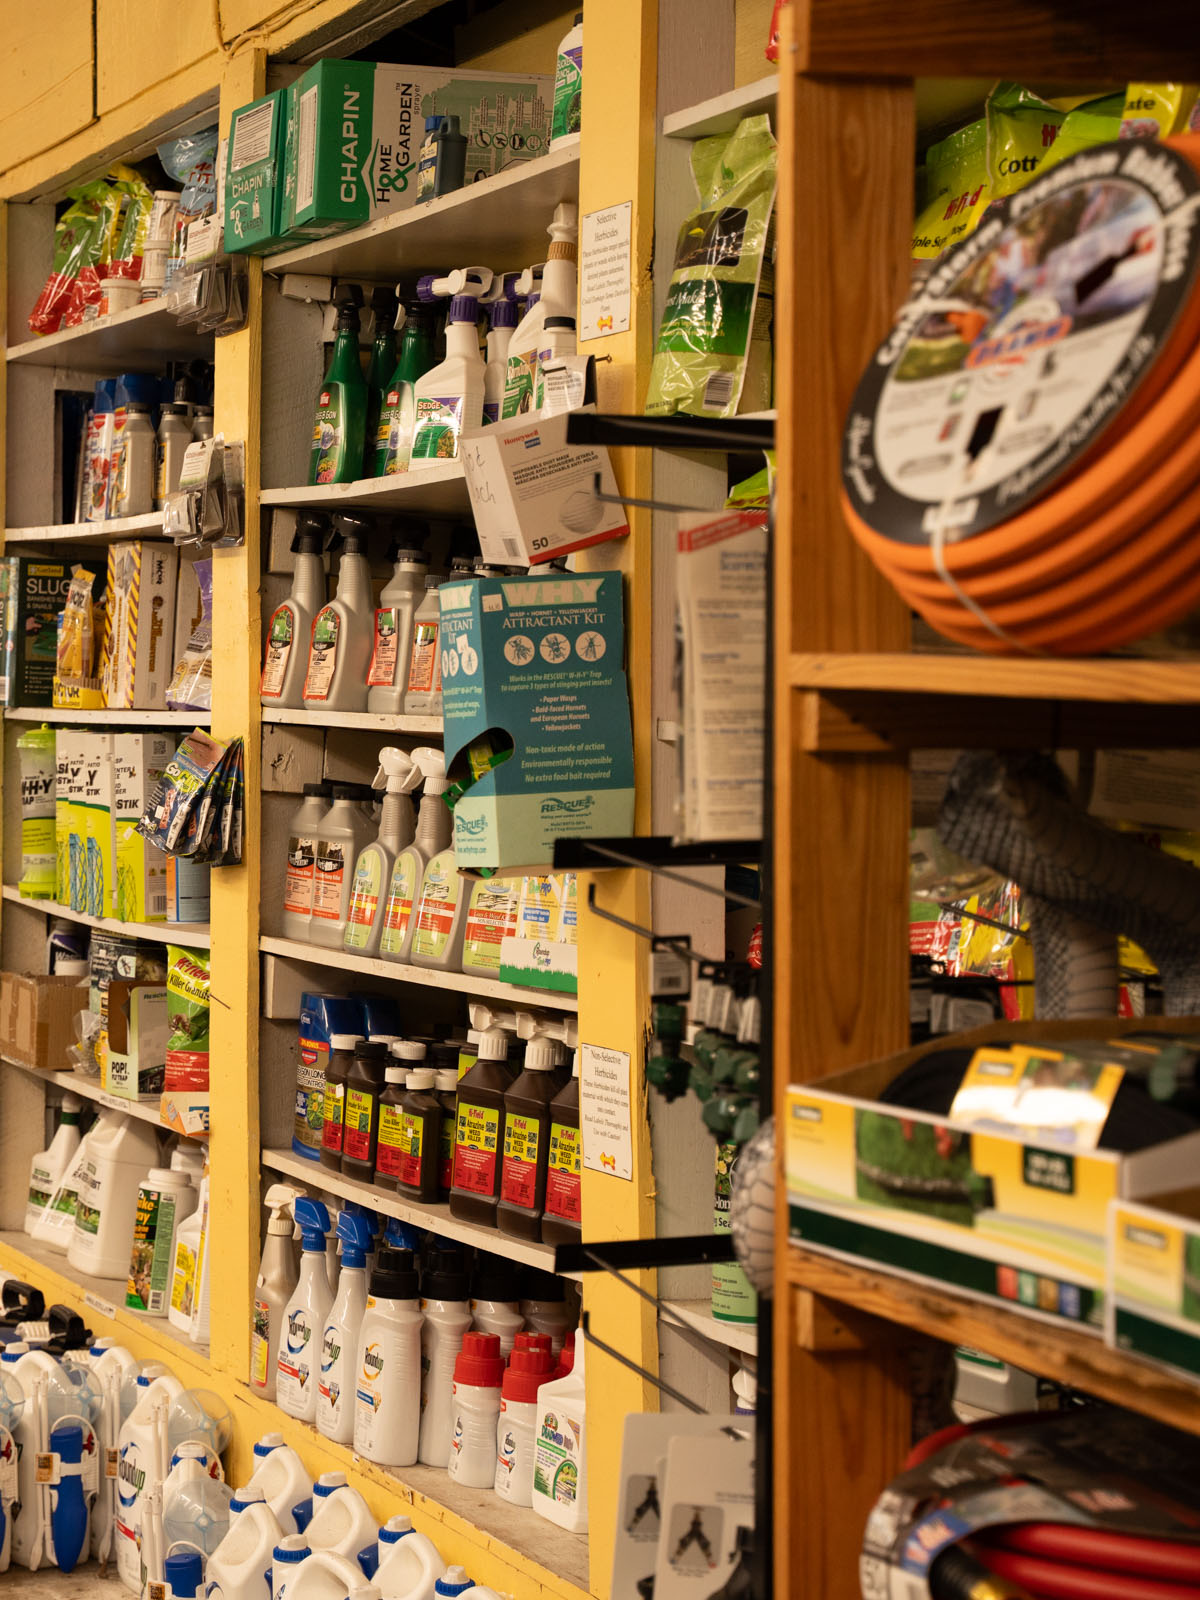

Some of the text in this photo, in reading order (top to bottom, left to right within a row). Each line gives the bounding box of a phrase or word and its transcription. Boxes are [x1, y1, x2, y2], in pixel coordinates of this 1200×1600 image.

[413, 84, 422, 115] sprayer
[396, 82, 414, 168] GARDEN
[340, 90, 361, 203] CHAPIN
[232, 174, 264, 199] CHAPIN
[596, 212, 618, 225] Selective
[417, 401, 441, 410] SEDGE
[417, 411, 440, 420] END
[504, 429, 539, 446] Honeywell
[513, 453, 569, 476] DISPOSABLE DUST MASK
[514, 469, 535, 480] MASQUE
[539, 465, 571, 479] DESECHABLE
[532, 536, 549, 551] 50
[25, 578, 72, 595] SLUG
[502, 578, 604, 607] WHY
[559, 607, 598, 615] YELLOWJACKET
[502, 612, 606, 629] ATTRACTANT KIT
[509, 675, 527, 683] Works
[533, 674, 542, 682] the
[589, 671, 602, 679] Trap
[535, 682, 549, 690] types
[556, 680, 578, 689] stinging
[579, 680, 591, 688] pest
[543, 695, 577, 704] Paper Wasps
[535, 704, 587, 713] Bald-faced Hornets
[530, 713, 590, 723] and European Hornets
[545, 723, 581, 732] Yellowjackets
[525, 744, 557, 754] Non-toxic
[576, 742, 585, 751] of
[584, 742, 606, 751] action
[521, 755, 613, 769] Environmentally responsible
[525, 770, 611, 783] No extra food bait required
[116, 799, 140, 810] STIK
[169, 973, 211, 1003] Killer Granule
[591, 1049, 622, 1065] Non-Selective
[111, 1061, 128, 1074] POP!
[594, 1066, 618, 1081] Herbicides
[468, 1108, 485, 1120] Hi-Yield
[466, 1119, 485, 1131] Atrazine
[513, 1118, 527, 1130] Hi-Yield
[467, 1134, 482, 1143] KILLER
[469, 1129, 481, 1137] WEED
[512, 1130, 527, 1141] Atrazine
[560, 1129, 575, 1141] Hi-Yield
[513, 1139, 524, 1147] WEED
[558, 1141, 576, 1153] Atrazine
[512, 1145, 524, 1154] KILLER
[560, 1151, 572, 1159] WEED
[558, 1156, 572, 1166] KILLER
[287, 1314, 312, 1343] Roundup
[364, 1346, 384, 1372] Roundup
[118, 1458, 146, 1497] oundup
